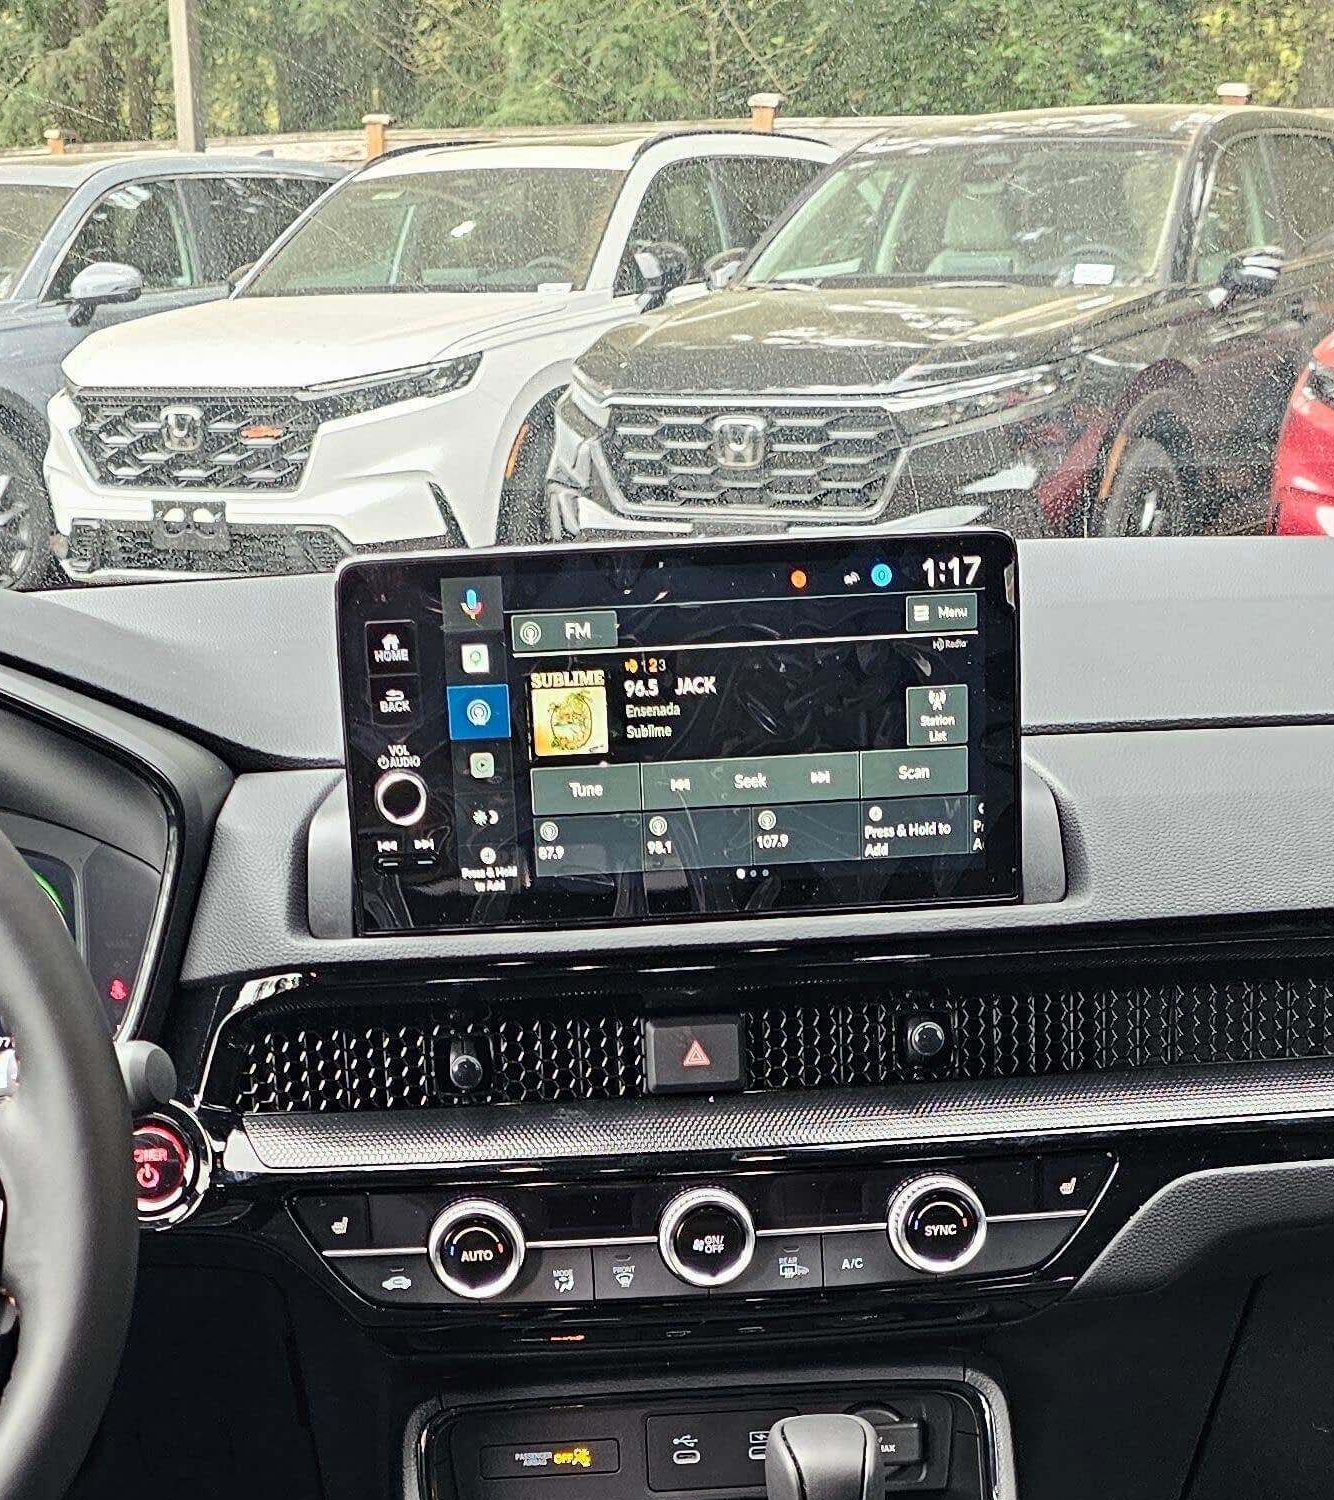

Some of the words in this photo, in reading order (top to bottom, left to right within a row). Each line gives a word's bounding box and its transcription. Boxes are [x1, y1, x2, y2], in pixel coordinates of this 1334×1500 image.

[922, 556, 982, 587] 1:17
[938, 605, 968, 619] Menu
[565, 622, 592, 641] FM
[373, 648, 410, 662] HOME
[648, 657, 658, 673] 2
[658, 658, 666, 672] 3
[530, 669, 605, 688] SUBLIME
[623, 678, 660, 698] 96.5
[675, 675, 718, 696] JACK
[379, 700, 412, 713] BACK
[625, 702, 680, 718] Ensenada
[920, 714, 956, 727] Station
[626, 724, 673, 739] Sublime
[928, 730, 948, 743] List
[387, 744, 410, 756] VOL
[390, 755, 421, 768] AUDIO
[898, 765, 931, 781] Scan
[734, 773, 768, 790] Seek
[569, 782, 603, 798] Tune
[864, 825, 895, 839] Press
[896, 823, 908, 838] &
[908, 821, 937, 837] Hold
[937, 822, 952, 835] to
[756, 834, 789, 849] 107.9
[864, 842, 889, 857] Add
[924, 1224, 957, 1237] SYNC
[460, 1249, 494, 1263] AUTO
[704, 1243, 724, 1254] OFF
[841, 1258, 864, 1270] A/C
